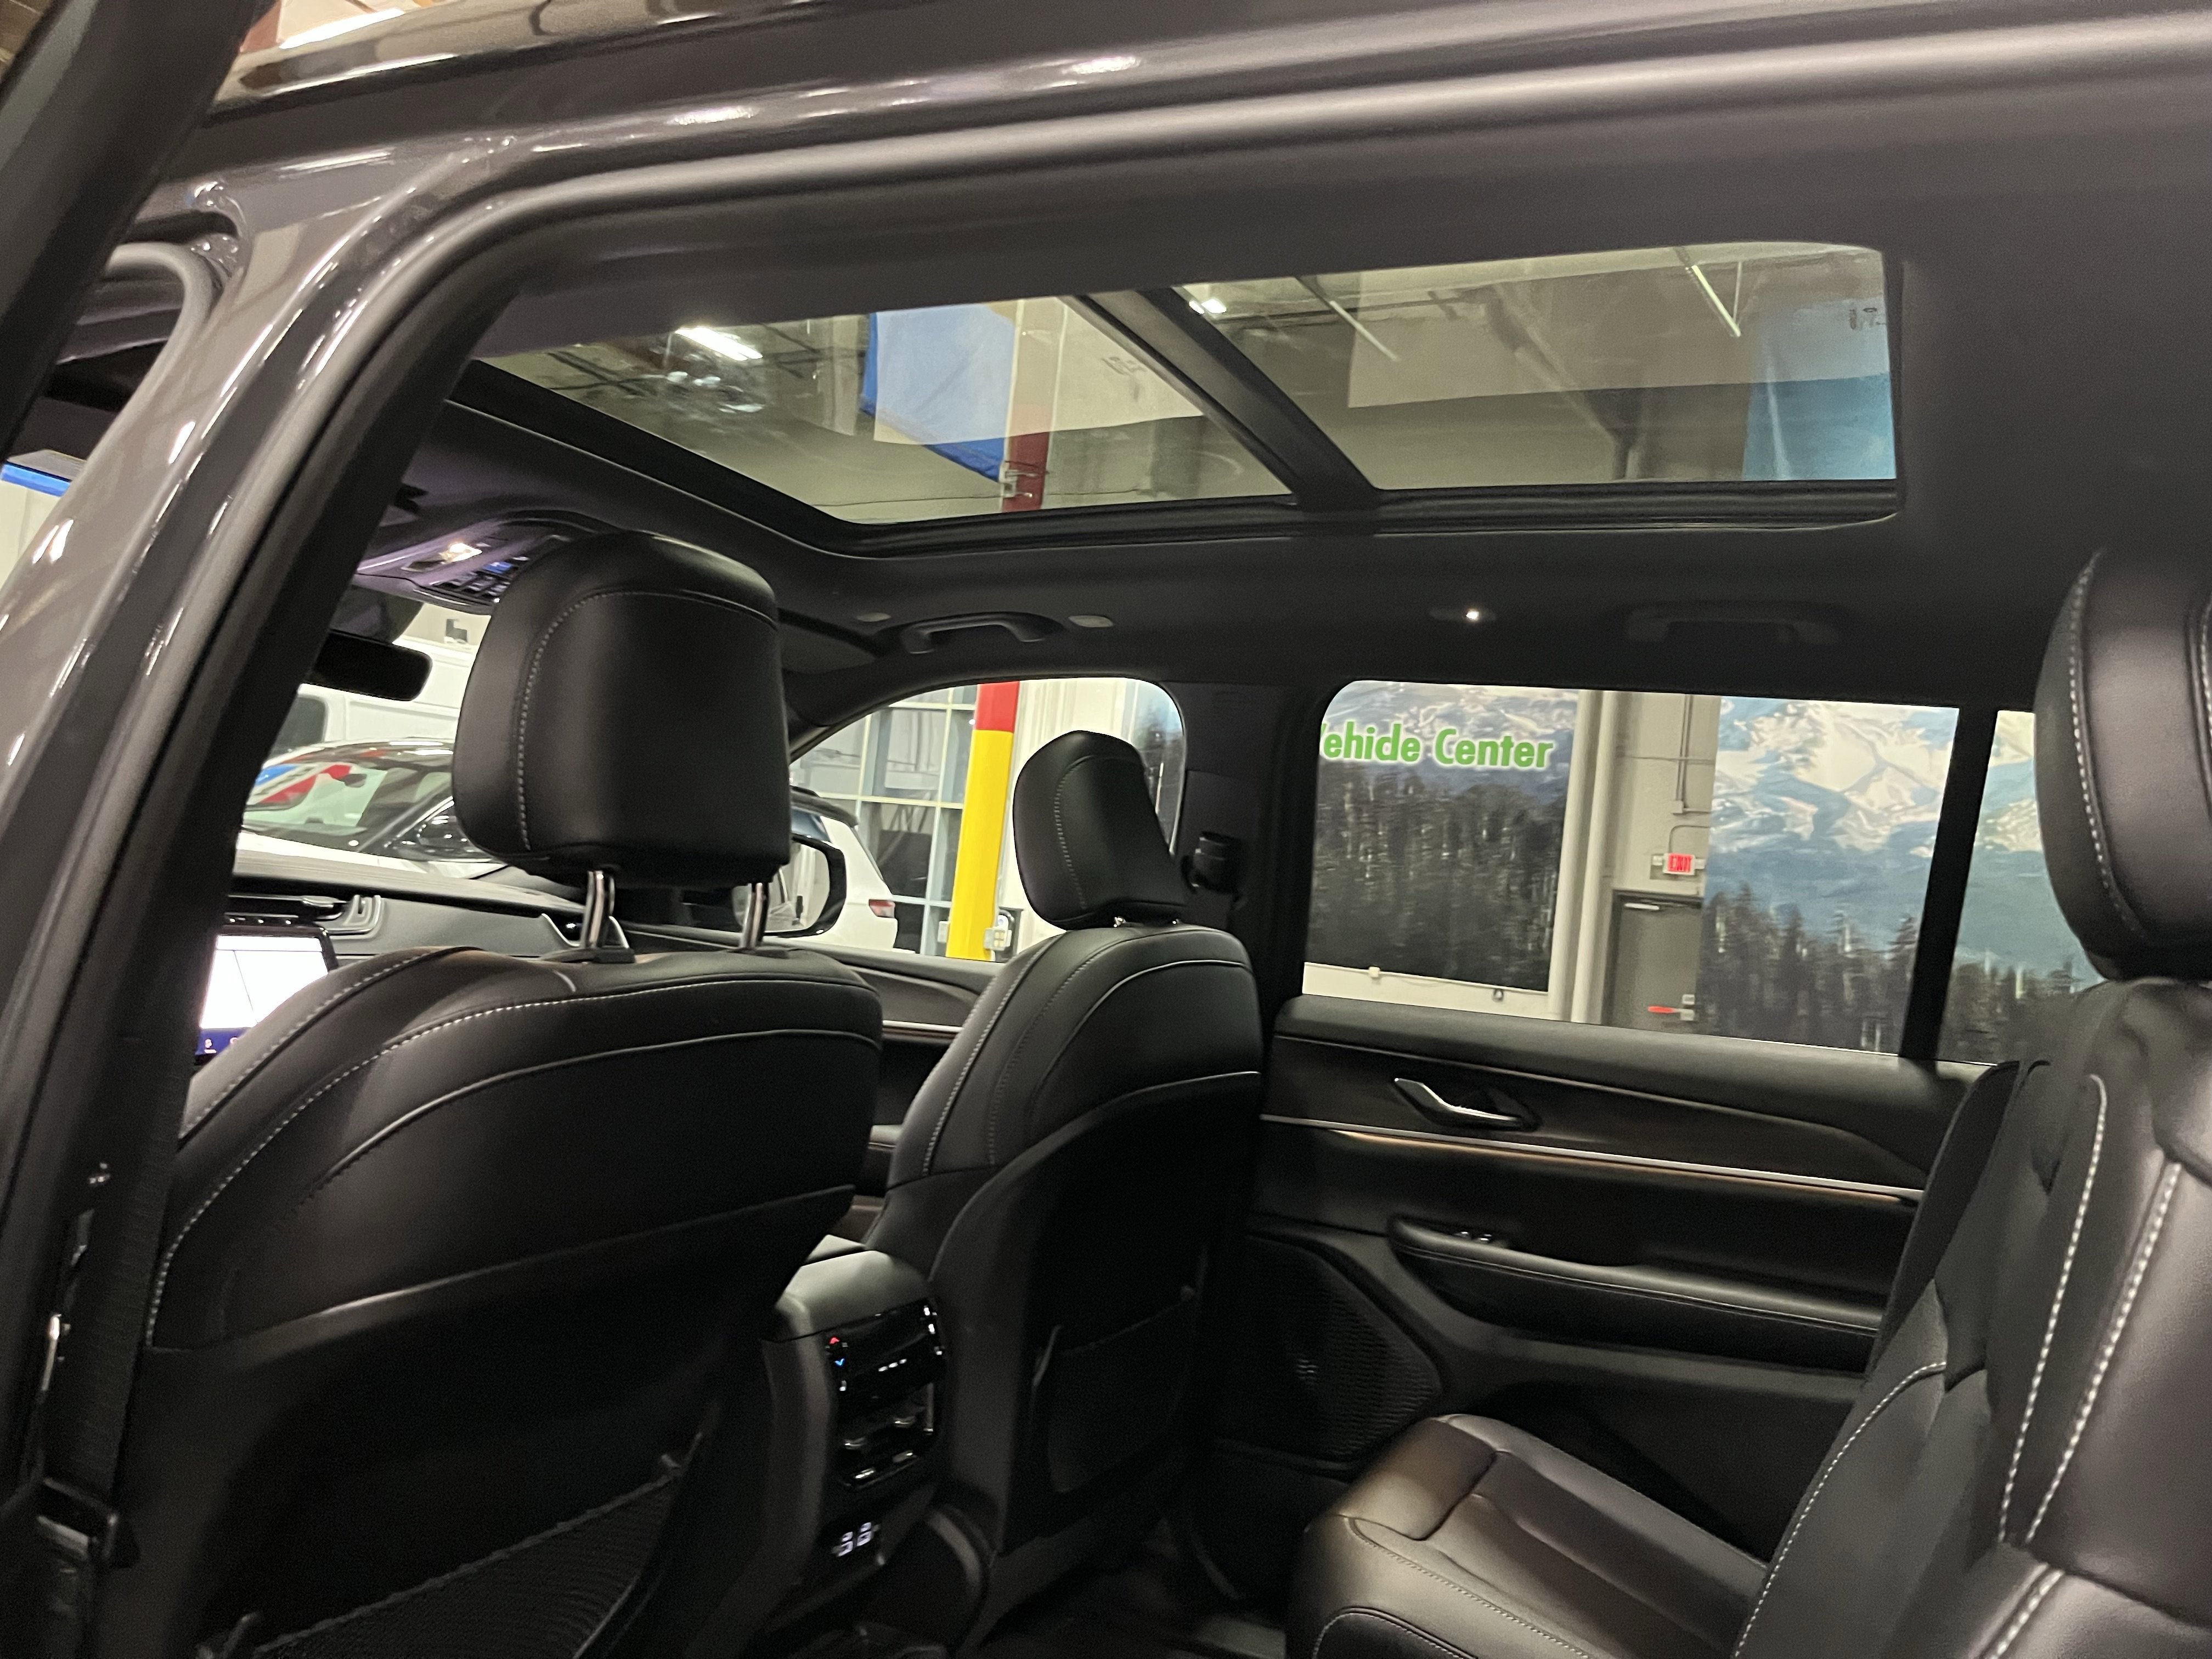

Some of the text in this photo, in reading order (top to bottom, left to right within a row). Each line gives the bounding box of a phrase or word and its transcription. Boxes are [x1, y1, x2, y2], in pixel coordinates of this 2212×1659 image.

[1321, 721, 1553, 768] ehicle Center
[1668, 854, 1692, 872] EXIT
